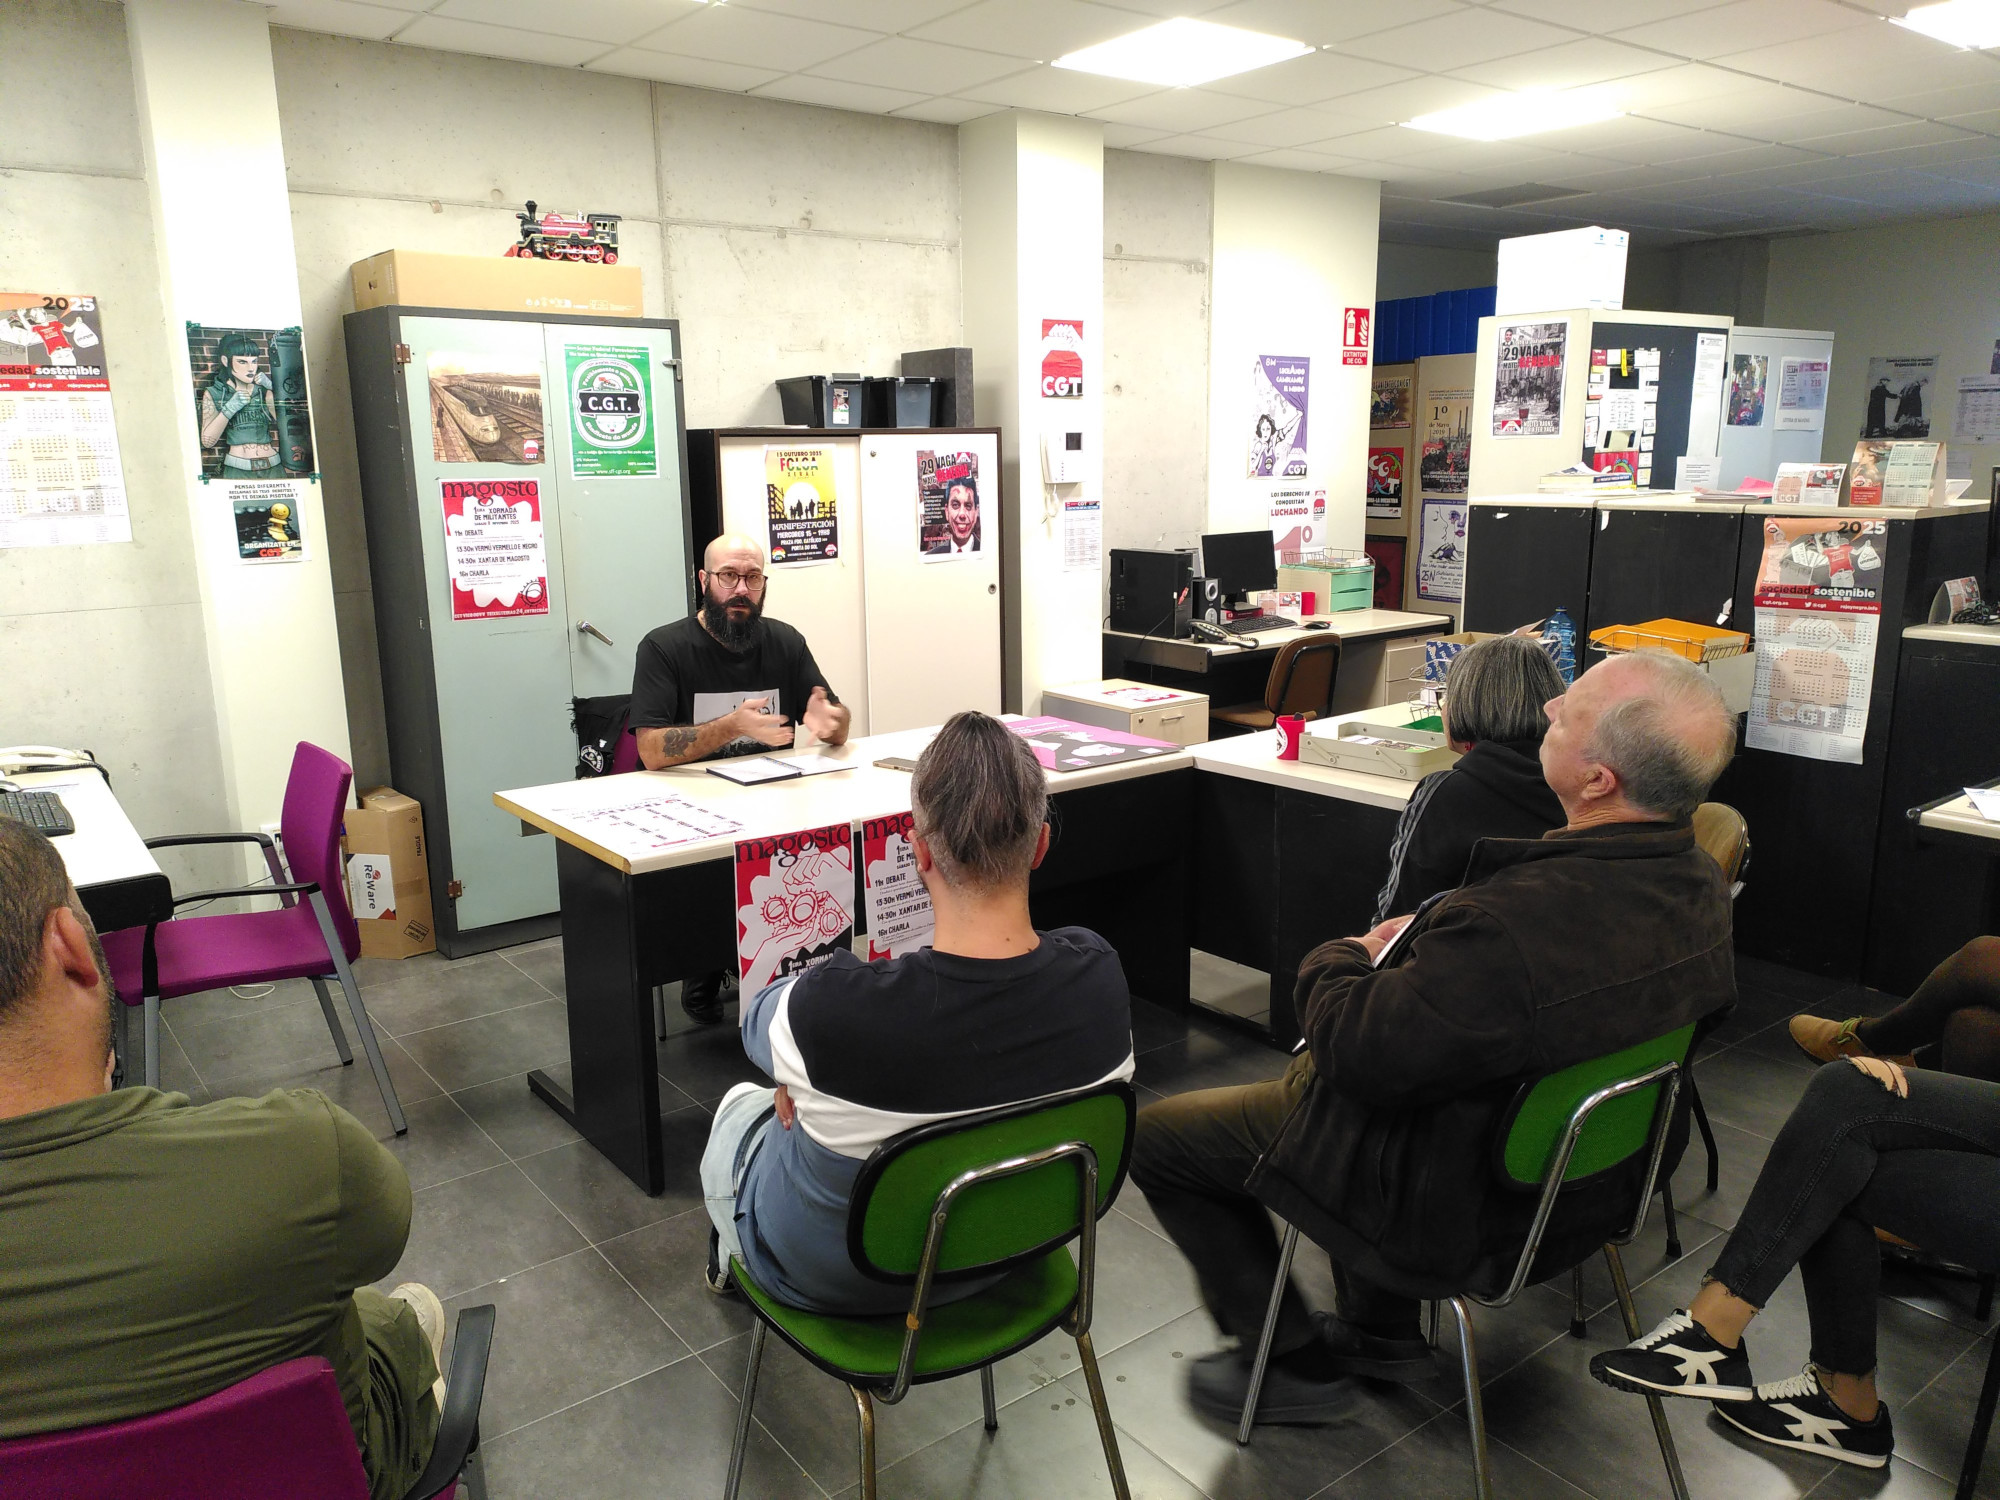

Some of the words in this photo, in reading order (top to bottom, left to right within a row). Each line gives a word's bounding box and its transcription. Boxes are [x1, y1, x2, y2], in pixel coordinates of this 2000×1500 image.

[42, 296, 96, 312] 2025
[1503, 346, 1519, 361] 29
[1520, 344, 1545, 357] VAGA
[35, 365, 101, 376] sostenible
[1042, 375, 1082, 397] CGT
[588, 396, 632, 411] C.G.T.
[921, 458, 935, 475] 29
[935, 453, 957, 469] VAGA
[1288, 464, 1306, 475] CGT
[1368, 454, 1400, 494] CGT
[441, 480, 539, 507] magosto
[1270, 507, 1309, 517] LUCHANDO
[772, 519, 835, 531] MANIFESTACIÓN
[1838, 520, 1886, 535] 2025
[259, 548, 282, 557] CGT
[1760, 584, 1812, 595] sociedad
[1813, 586, 1876, 598] sostenible
[1777, 700, 1839, 728] CGT
[735, 823, 852, 868] magosto
[897, 855, 905, 863] DE
[885, 873, 906, 885] DEBATE
[363, 864, 376, 910] ReWare
[895, 888, 915, 902] VERMÚ
[898, 903, 921, 917] XANTAR
[921, 901, 929, 910] DE
[888, 922, 910, 934] CHARLA
